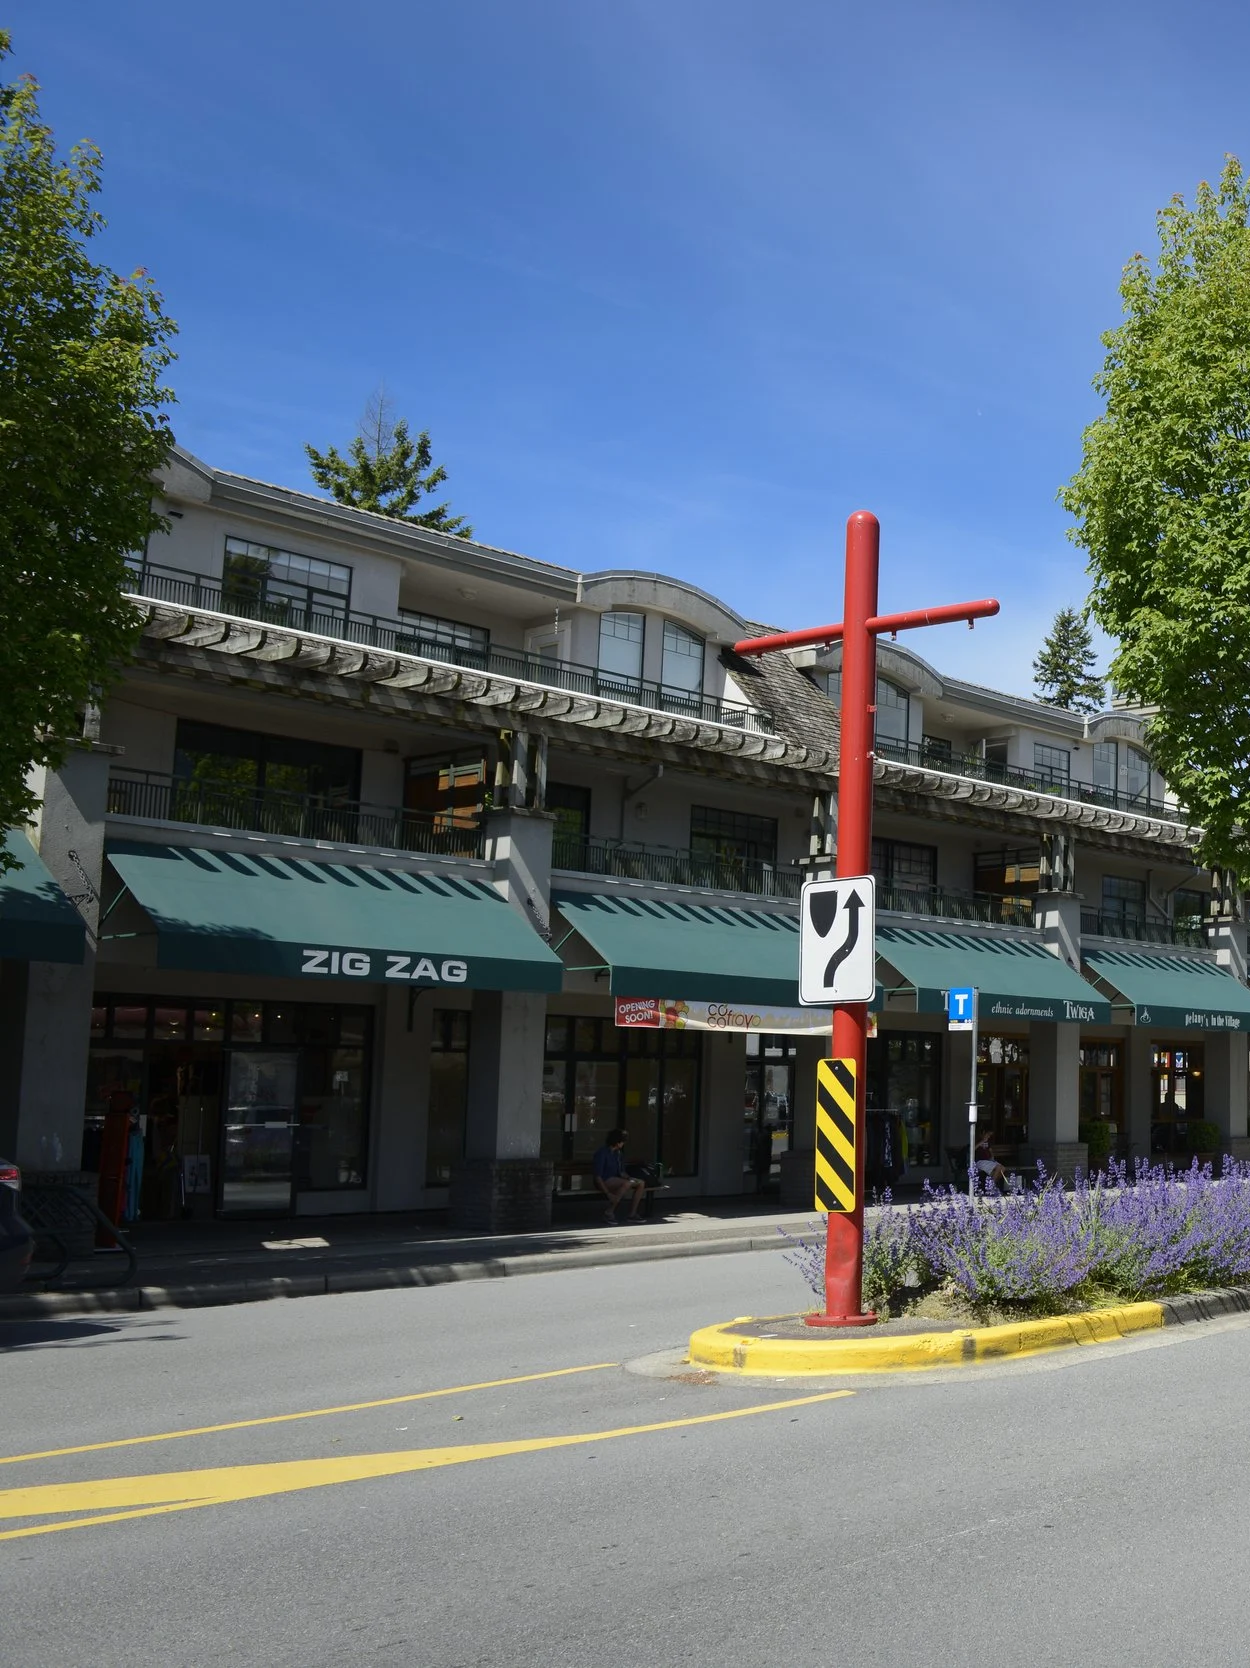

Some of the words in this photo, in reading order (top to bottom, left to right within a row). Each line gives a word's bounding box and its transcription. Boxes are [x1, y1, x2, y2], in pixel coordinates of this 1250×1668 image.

[301, 949, 371, 976] ZIG
[385, 955, 468, 983] ZAG
[619, 1000, 655, 1014] OPENING
[954, 993, 968, 1015] T
[991, 1000, 1013, 1015] ethnic
[1015, 1003, 1054, 1018] adornments
[625, 1011, 653, 1024] SOON!
